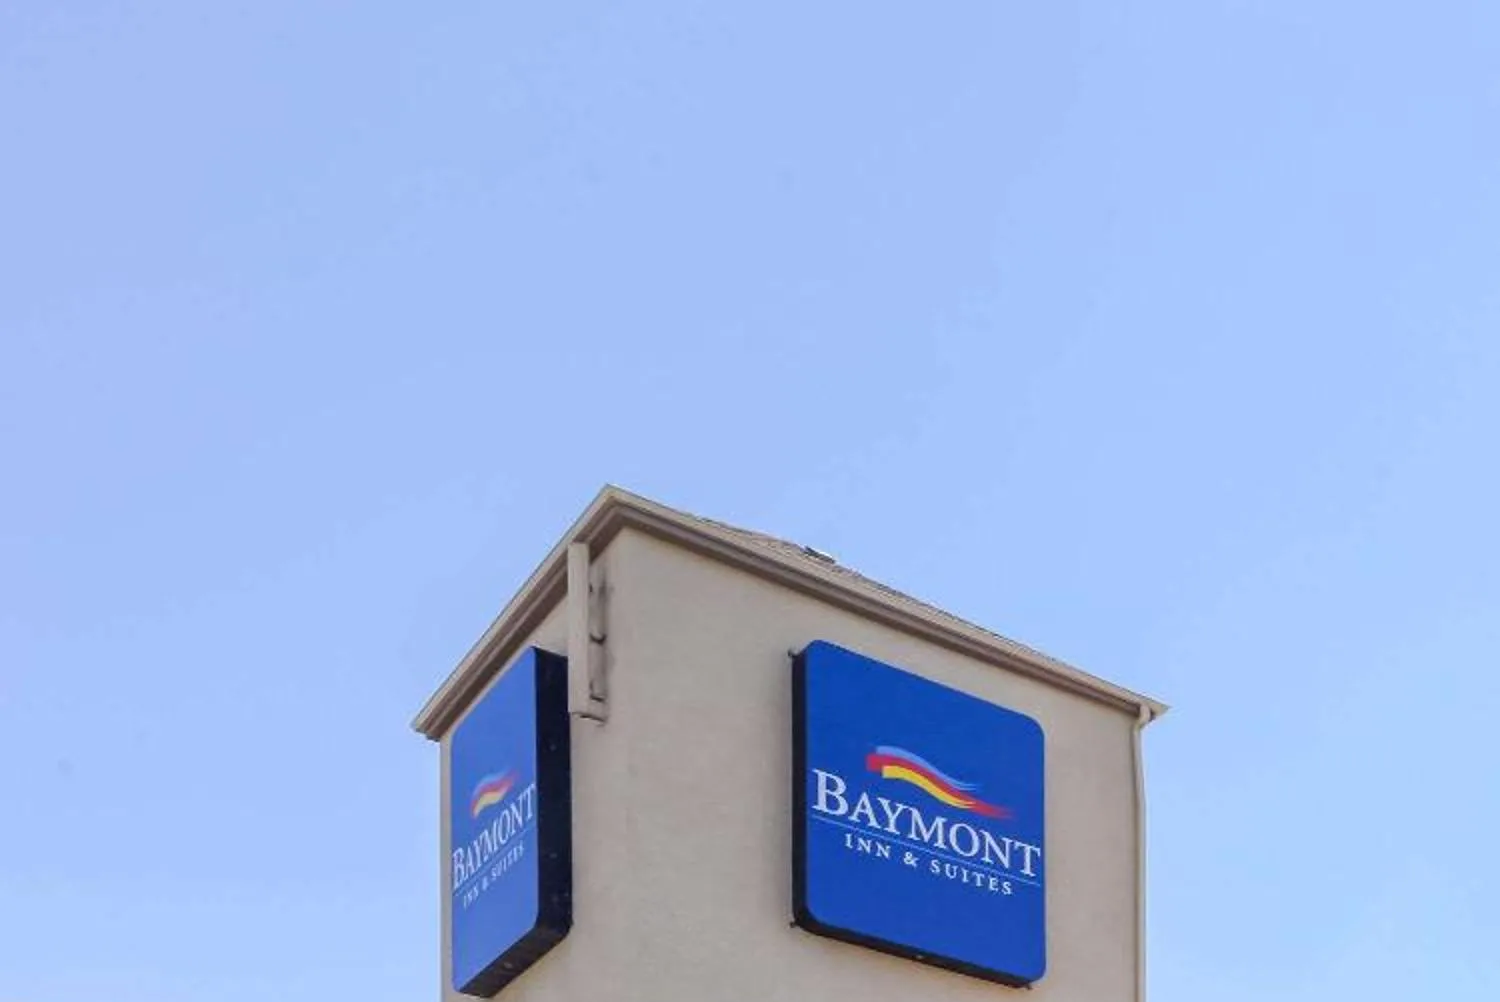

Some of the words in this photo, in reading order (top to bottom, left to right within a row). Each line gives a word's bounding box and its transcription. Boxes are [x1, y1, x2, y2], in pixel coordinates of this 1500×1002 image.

[453, 783, 536, 890] BAYMONT
[811, 768, 1041, 877] BAYMONT
[844, 833, 891, 859] INN
[903, 851, 919, 868] &
[931, 859, 1013, 896] SUITES
